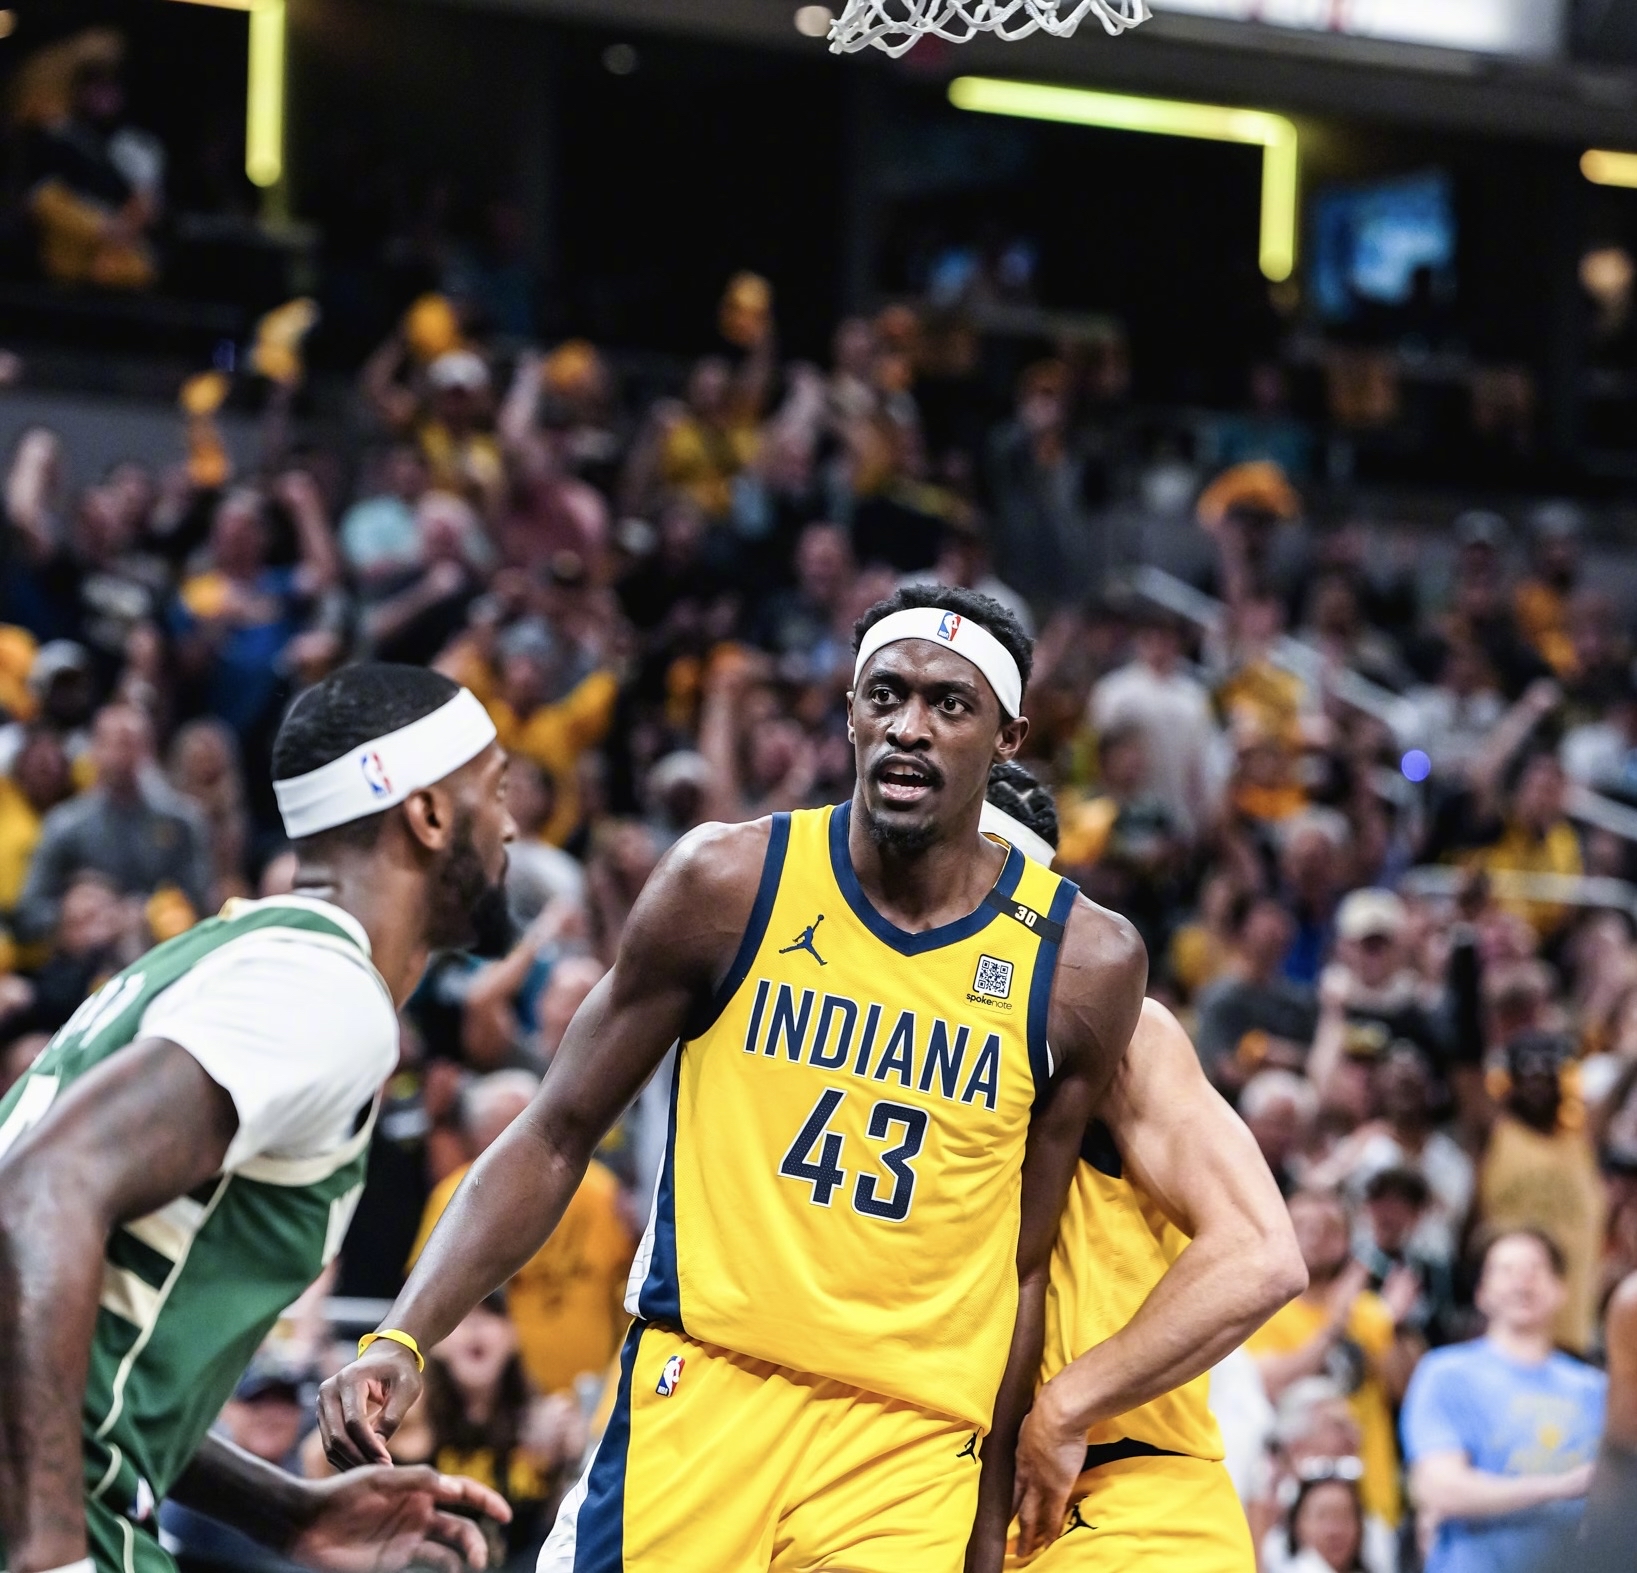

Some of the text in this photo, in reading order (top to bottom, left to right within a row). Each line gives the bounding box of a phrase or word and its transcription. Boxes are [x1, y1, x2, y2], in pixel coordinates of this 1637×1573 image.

[1014, 905, 1038, 928] 30
[966, 992, 1013, 1010] spokenote
[743, 978, 1002, 1112] INDIANA
[778, 1087, 930, 1223] 43
